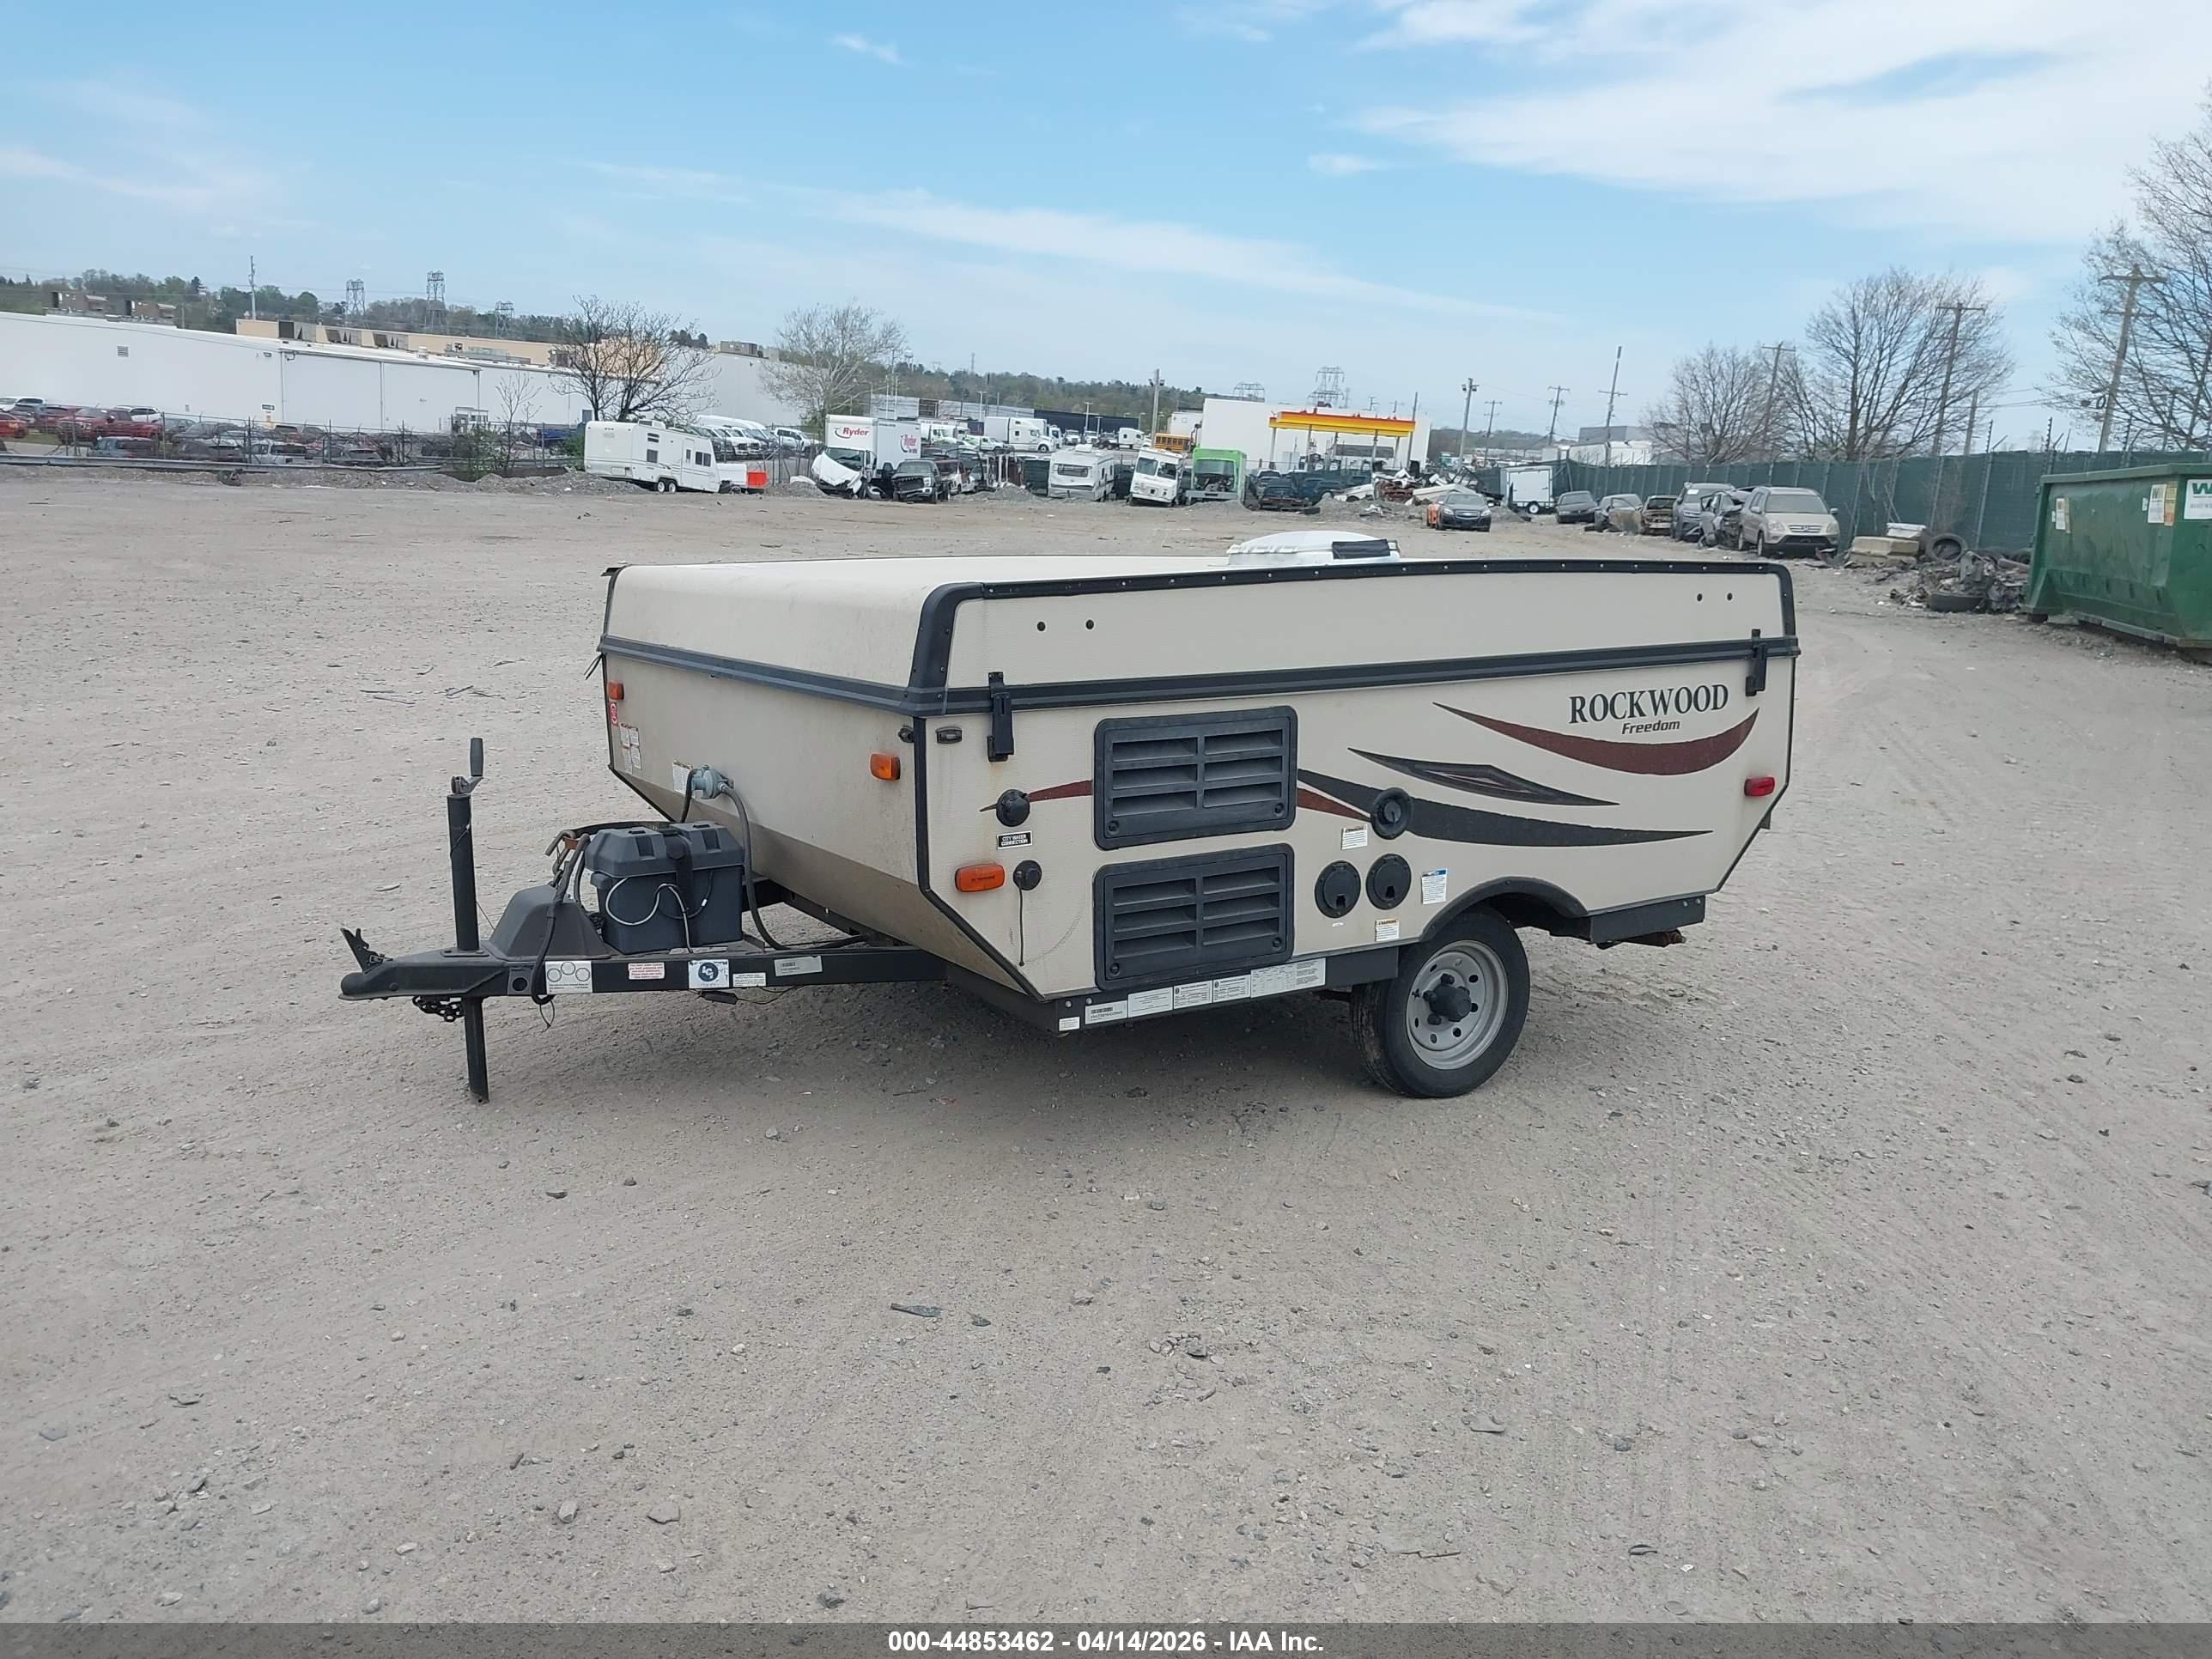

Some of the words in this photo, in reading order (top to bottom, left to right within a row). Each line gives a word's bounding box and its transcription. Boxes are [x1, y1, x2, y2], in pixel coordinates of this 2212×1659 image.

[842, 428, 869, 437] Ryder
[1569, 684, 1729, 724] ROCKWOOD
[1622, 720, 1680, 734] Freedom
